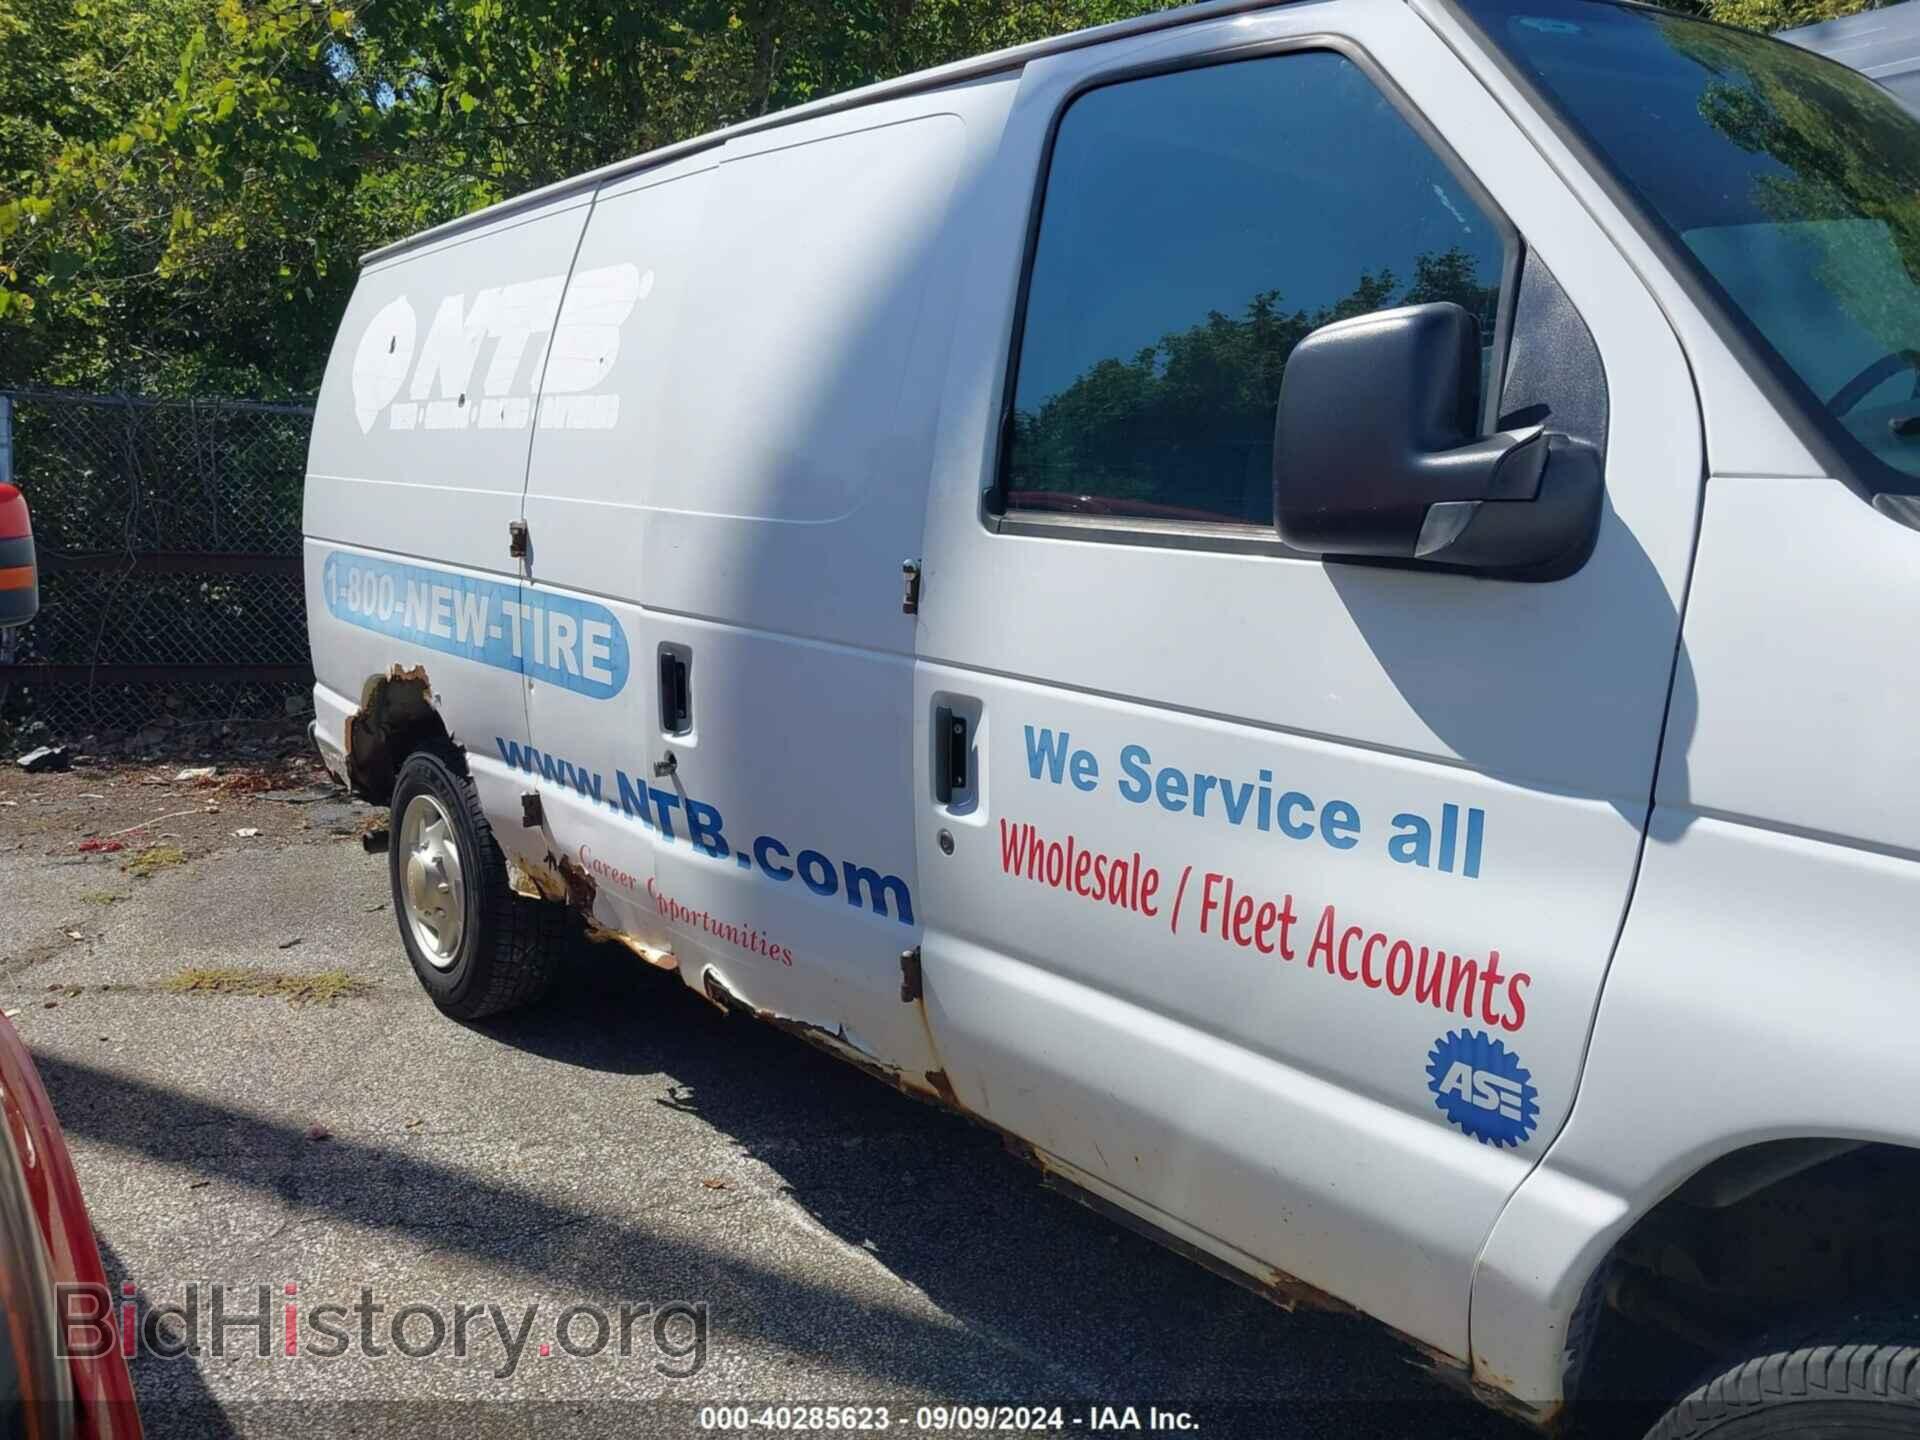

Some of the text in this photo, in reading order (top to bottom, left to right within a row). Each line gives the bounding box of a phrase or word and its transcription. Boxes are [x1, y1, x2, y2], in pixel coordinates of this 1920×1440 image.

[325, 561, 613, 686] 1-800-NEW-TIRE
[495, 736, 915, 926] www.NTB.com
[579, 844, 637, 890] Career
[1024, 725, 1485, 879] We Service all
[1000, 817, 1160, 917] Wholesale
[1199, 872, 1297, 960] Fleet
[1307, 904, 1531, 1032] Accounts
[1440, 1062, 1524, 1123] ASE
